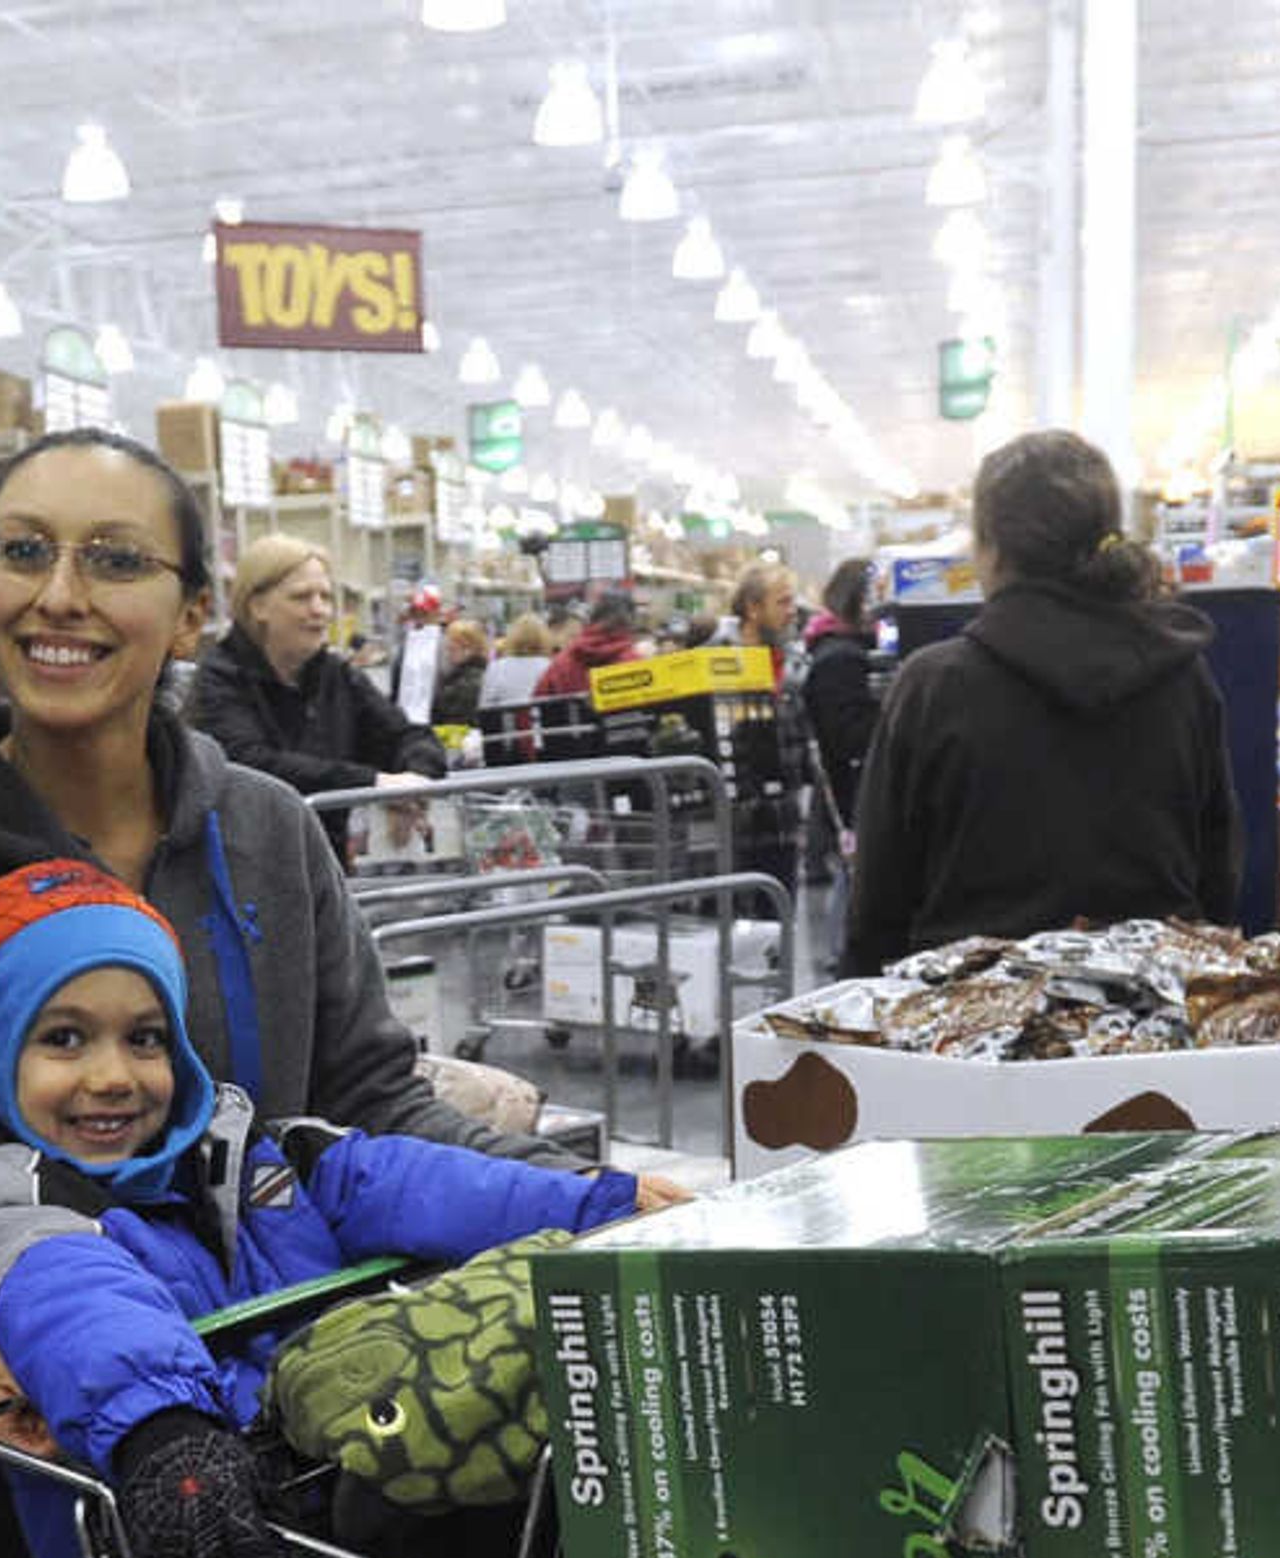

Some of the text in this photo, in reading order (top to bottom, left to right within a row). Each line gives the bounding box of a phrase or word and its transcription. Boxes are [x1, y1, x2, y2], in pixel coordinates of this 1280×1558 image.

[223, 241, 417, 334] TOYS!
[633, 1295, 655, 1359] costs
[758, 1295, 781, 1359] 52054
[1084, 1289, 1102, 1335] Light
[1125, 1288, 1152, 1361] costs
[785, 1353, 807, 1406] H172
[1089, 1340, 1107, 1381] with
[548, 1294, 609, 1506] Springhill
[641, 1368, 667, 1461] cooling
[1020, 1289, 1088, 1529] Springhill
[1093, 1385, 1111, 1417] Fan
[1131, 1371, 1161, 1476] cooling
[1099, 1422, 1116, 1484] Ceiling
[652, 1469, 670, 1502] on
[1146, 1485, 1168, 1524] on
[1103, 1488, 1121, 1548] Bronze
